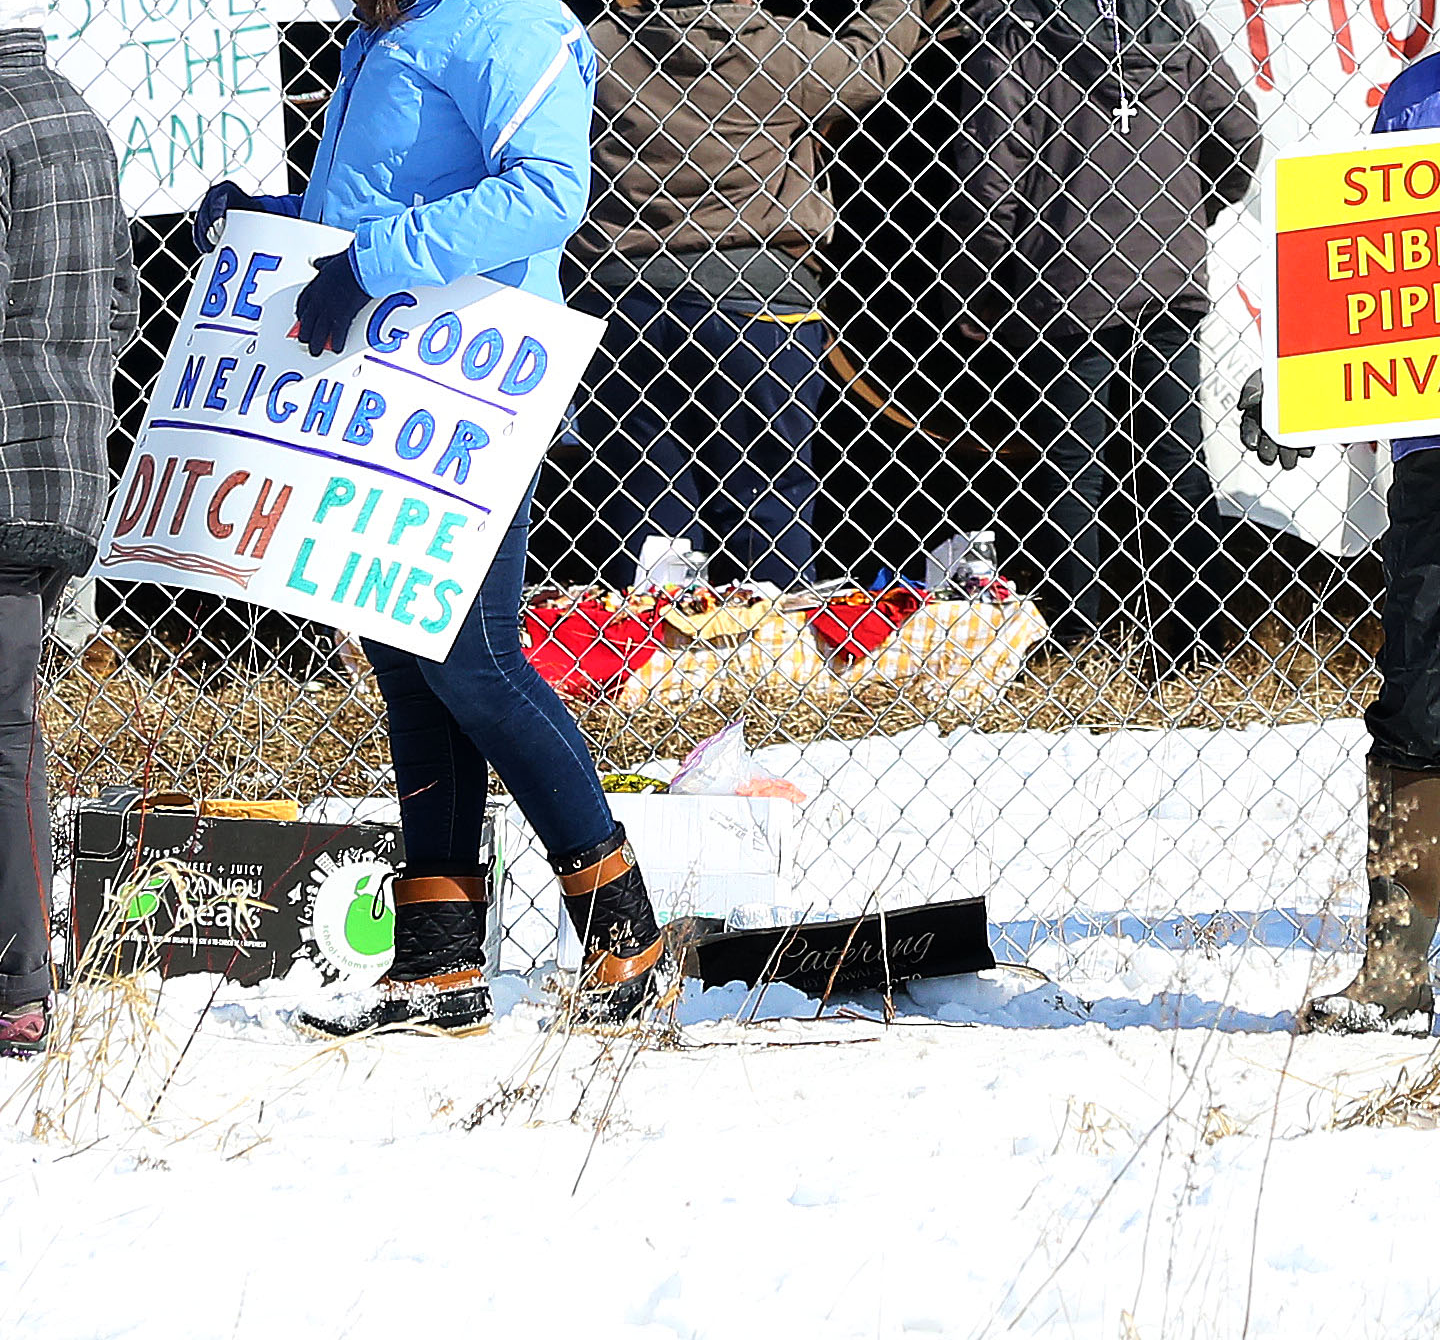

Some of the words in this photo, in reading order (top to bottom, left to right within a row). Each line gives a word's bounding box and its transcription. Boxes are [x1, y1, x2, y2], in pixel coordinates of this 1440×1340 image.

[120, 23, 270, 100] THE
[119, 111, 253, 188] AND
[198, 246, 282, 321] BE
[365, 291, 549, 397] GOOD
[171, 354, 492, 485] NEIGHBOR
[112, 455, 294, 560] DITCH
[313, 476, 469, 564] PIPE
[286, 539, 464, 635] LINES
[230, 864, 264, 876] JUICY
[767, 932, 936, 981] Catering
